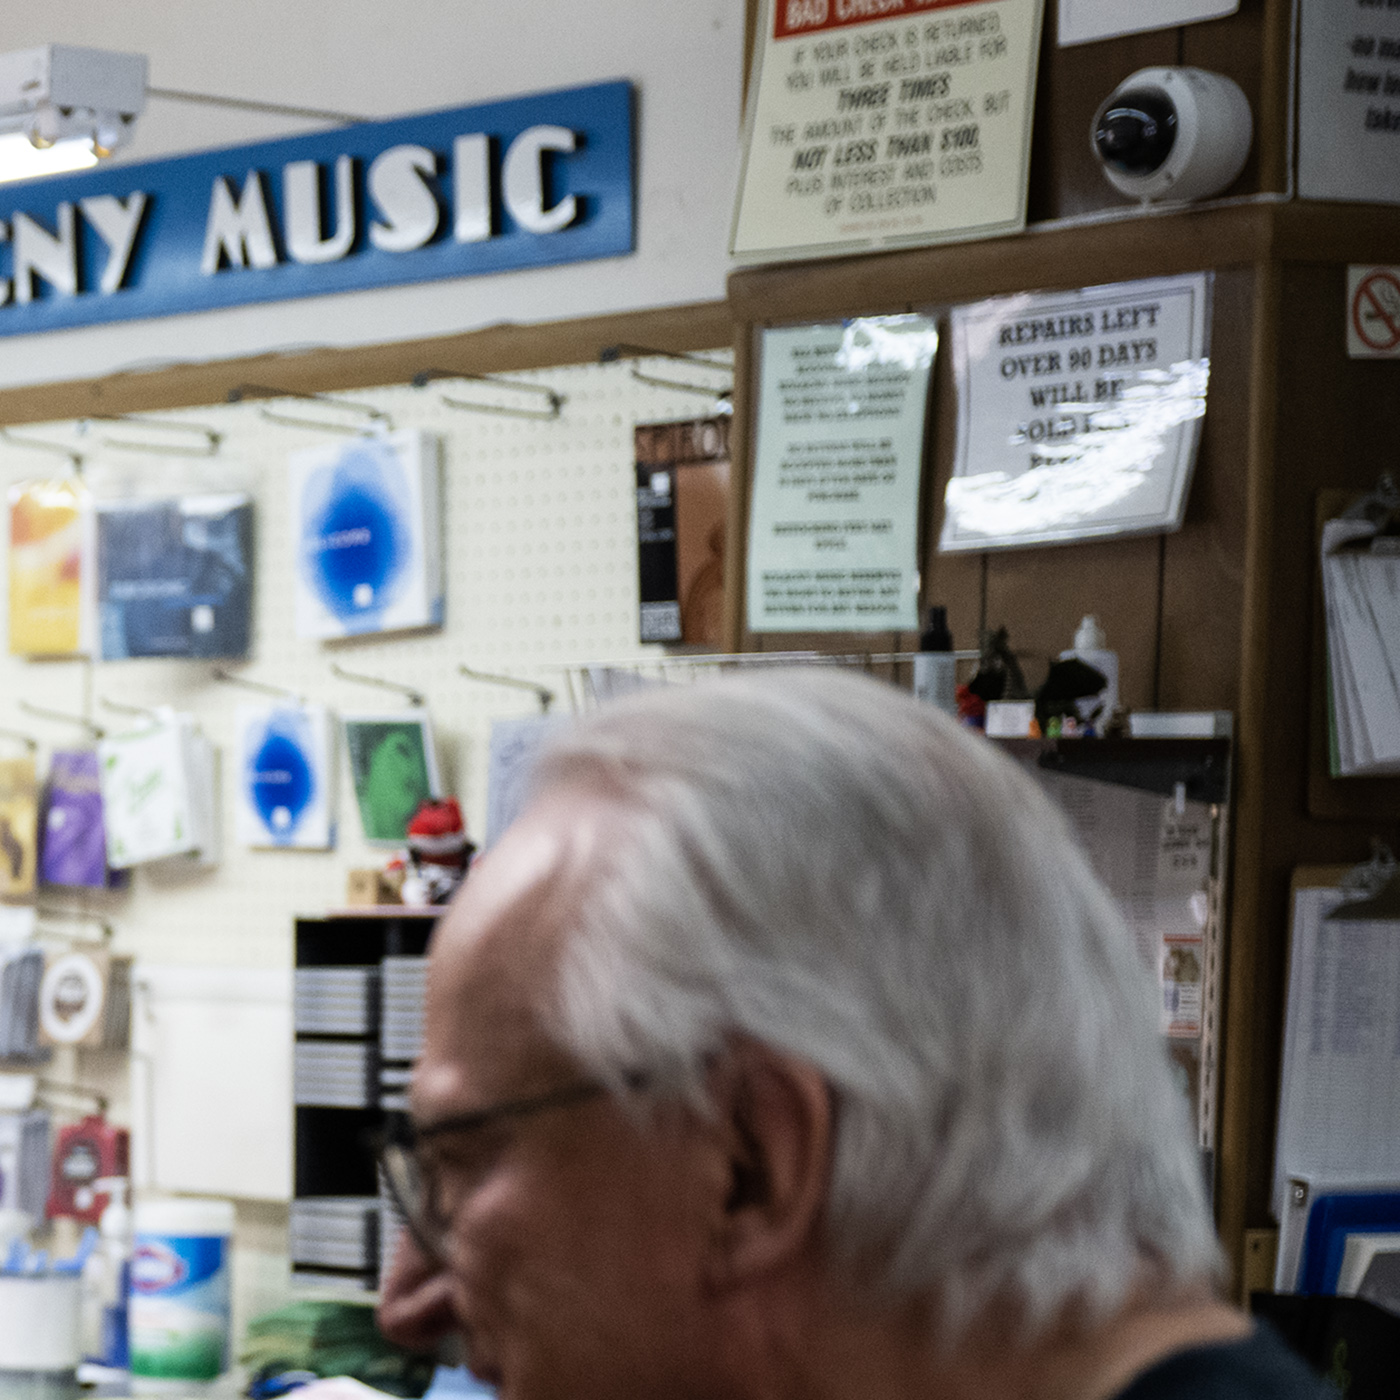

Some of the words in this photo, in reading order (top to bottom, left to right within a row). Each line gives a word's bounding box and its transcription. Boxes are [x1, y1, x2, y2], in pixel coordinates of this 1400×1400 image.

[838, 84, 891, 110] THREE
[900, 73, 950, 100] TIMES
[792, 146, 827, 171] NOT
[834, 140, 878, 166] LESS
[887, 133, 933, 159] THAN
[200, 125, 579, 276] MUSIC
[999, 313, 1095, 347] REPAIRS
[1102, 303, 1161, 331] LEFT
[1001, 350, 1061, 380] OVER
[1069, 347, 1093, 371] 90
[1099, 338, 1158, 366] DAYS
[1030, 380, 1089, 408] WILL
